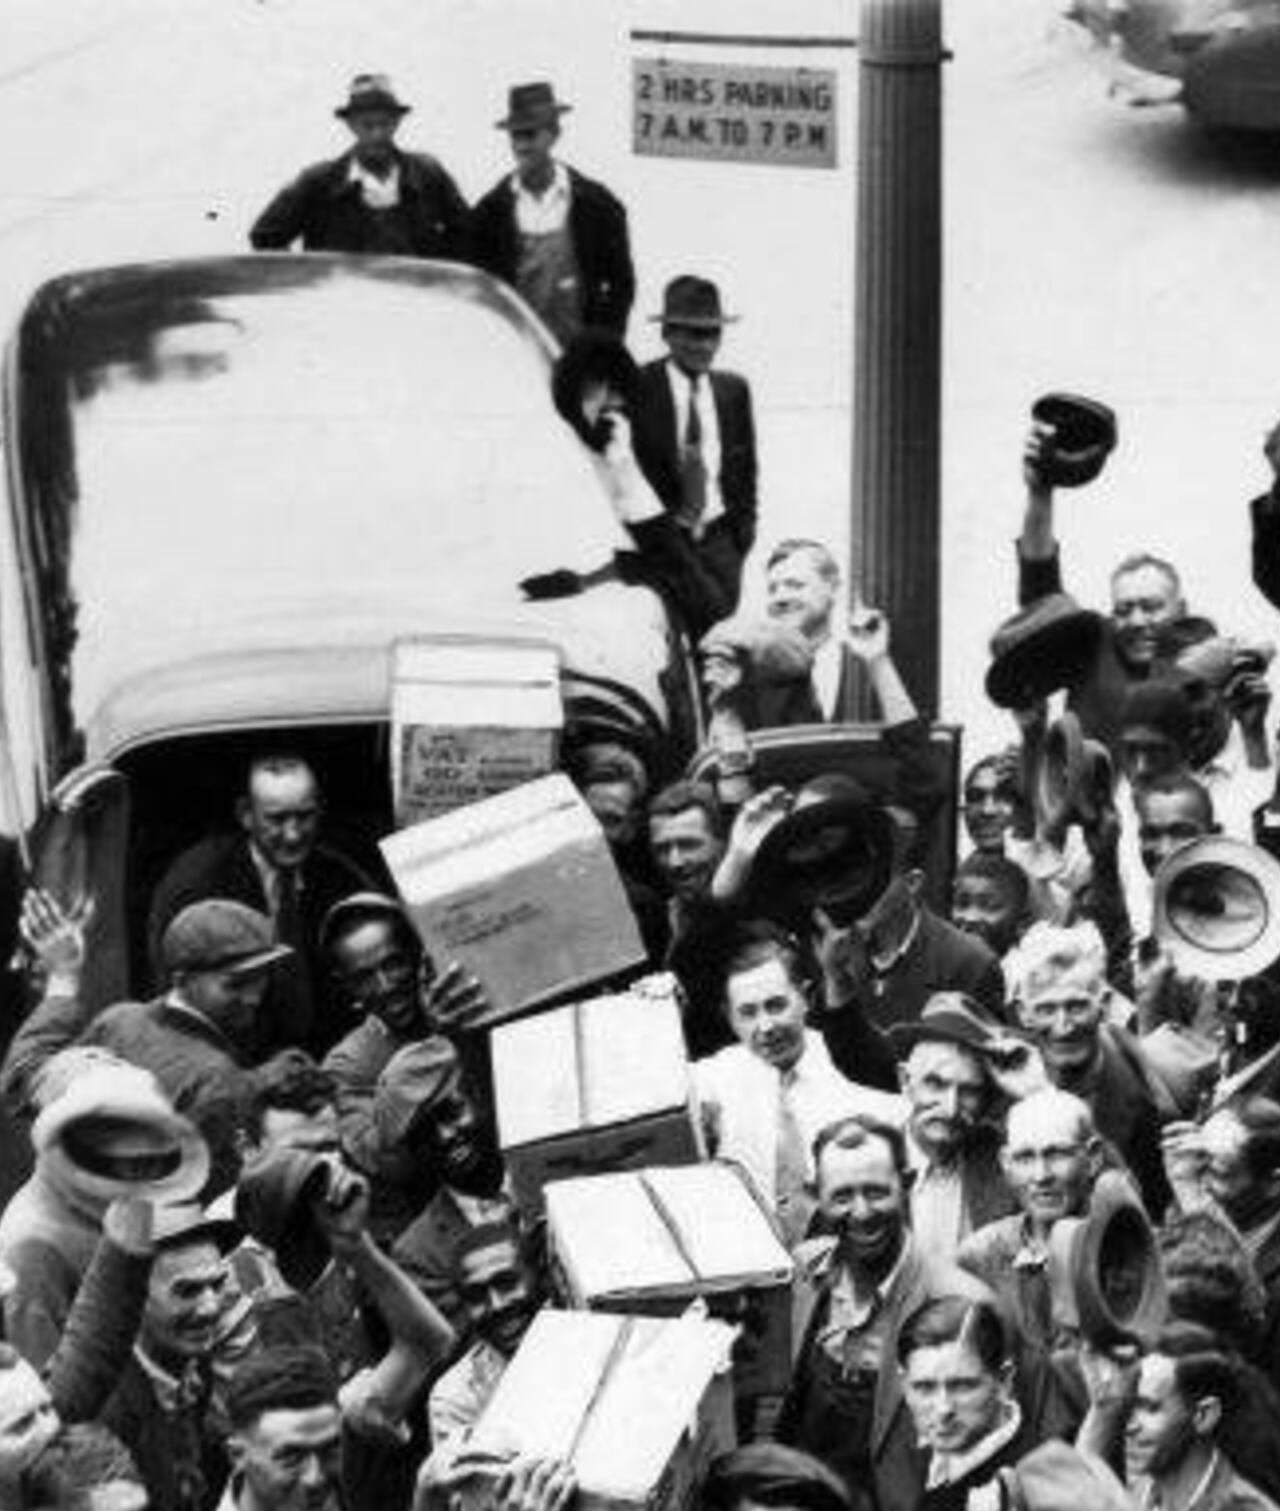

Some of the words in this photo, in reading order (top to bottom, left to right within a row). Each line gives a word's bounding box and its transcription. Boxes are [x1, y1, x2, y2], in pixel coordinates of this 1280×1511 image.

[638, 73, 653, 100] 2
[663, 77, 715, 105] HRS
[724, 81, 832, 112] PARKING
[638, 112, 654, 138] 7
[715, 117, 749, 147] TO
[760, 121, 774, 147] 7
